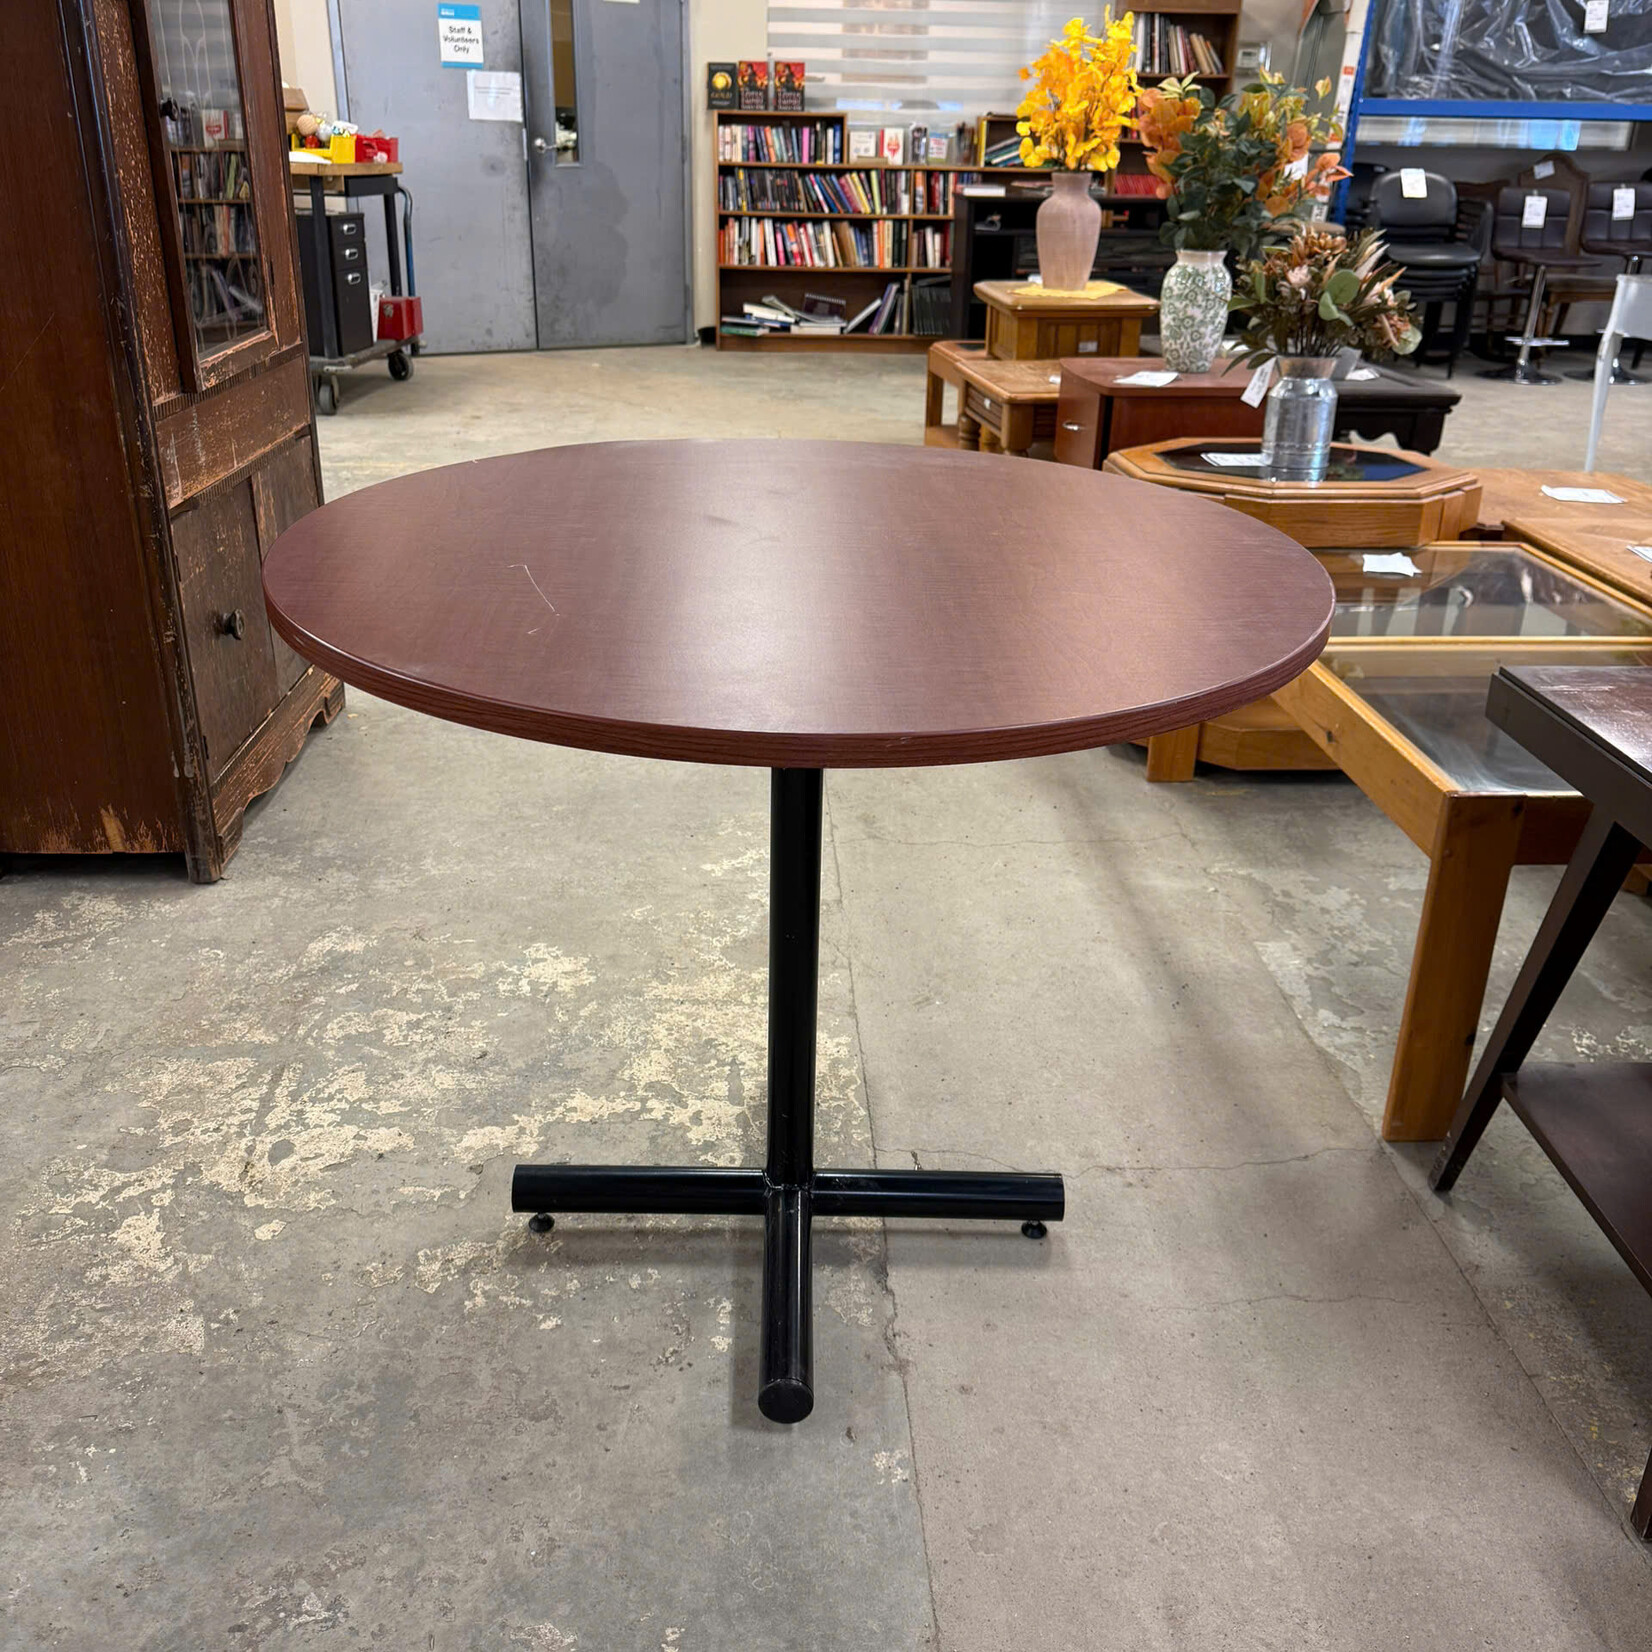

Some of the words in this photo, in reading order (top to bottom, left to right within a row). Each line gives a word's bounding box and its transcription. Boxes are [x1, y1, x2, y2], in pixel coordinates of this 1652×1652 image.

[449, 26, 465, 34] Staff
[443, 35, 479, 44] Volunteers
[454, 45, 469, 54] Only
